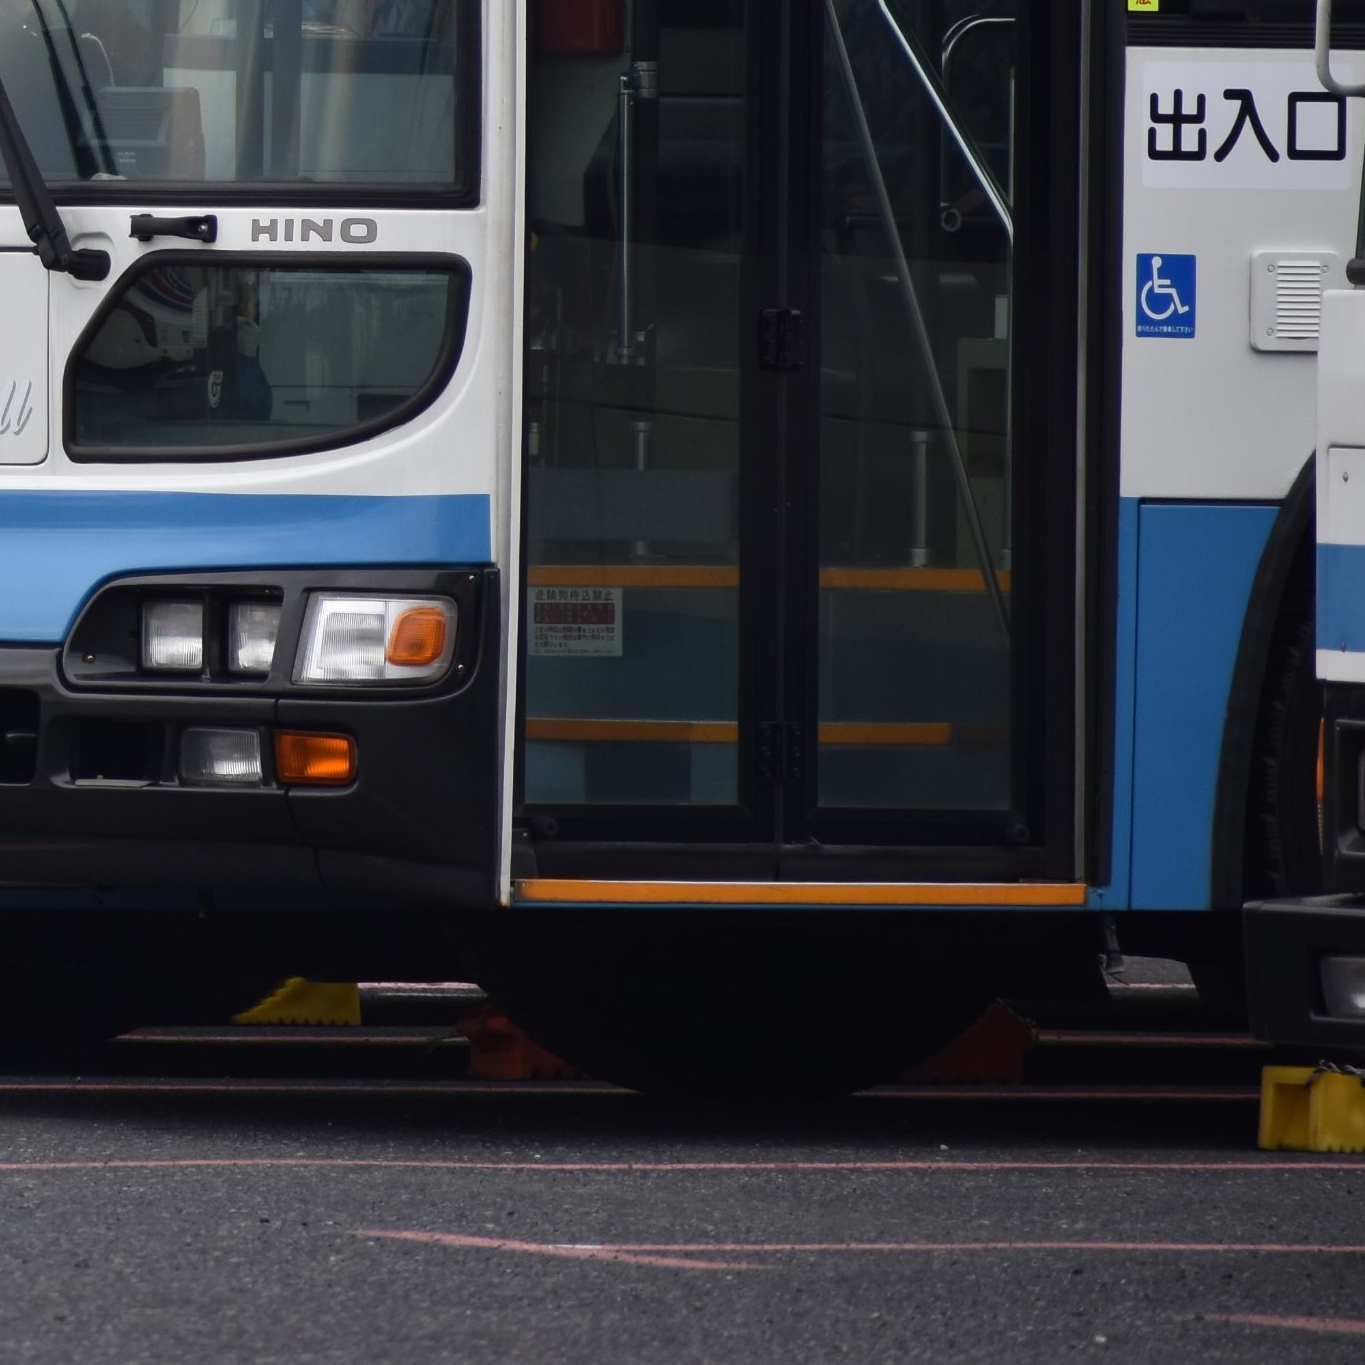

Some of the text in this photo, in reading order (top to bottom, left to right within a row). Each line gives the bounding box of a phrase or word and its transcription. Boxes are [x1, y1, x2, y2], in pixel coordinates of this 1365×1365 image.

[1147, 88, 1347, 163] 出入口
[251, 217, 378, 244] HINO
